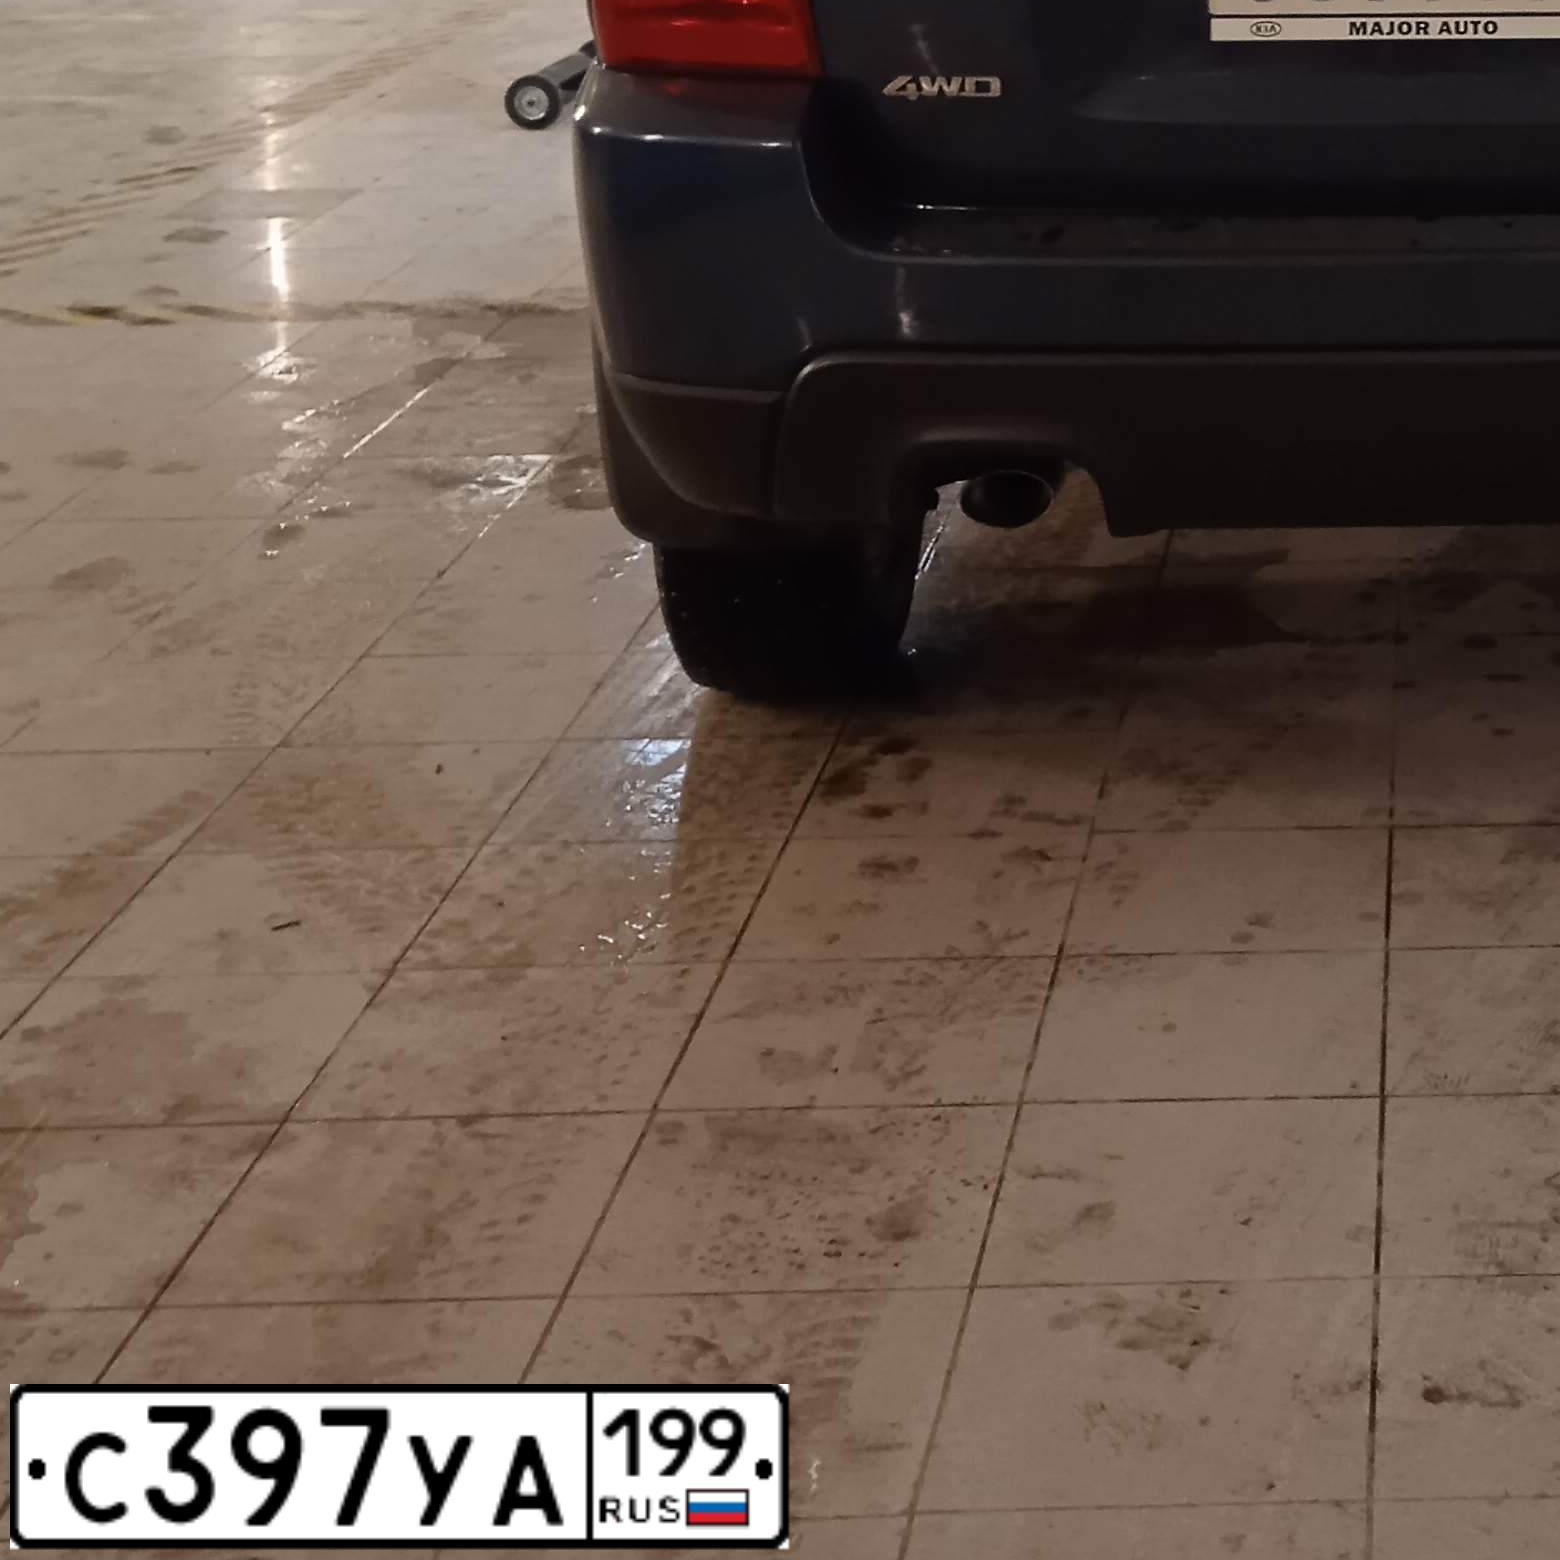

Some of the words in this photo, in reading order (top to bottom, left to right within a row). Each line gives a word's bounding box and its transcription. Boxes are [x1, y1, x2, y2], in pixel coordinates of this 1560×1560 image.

[1348, 20, 1430, 37] MAJOR
[1438, 20, 1498, 36] AUTO
[882, 75, 1001, 101] 4WD
